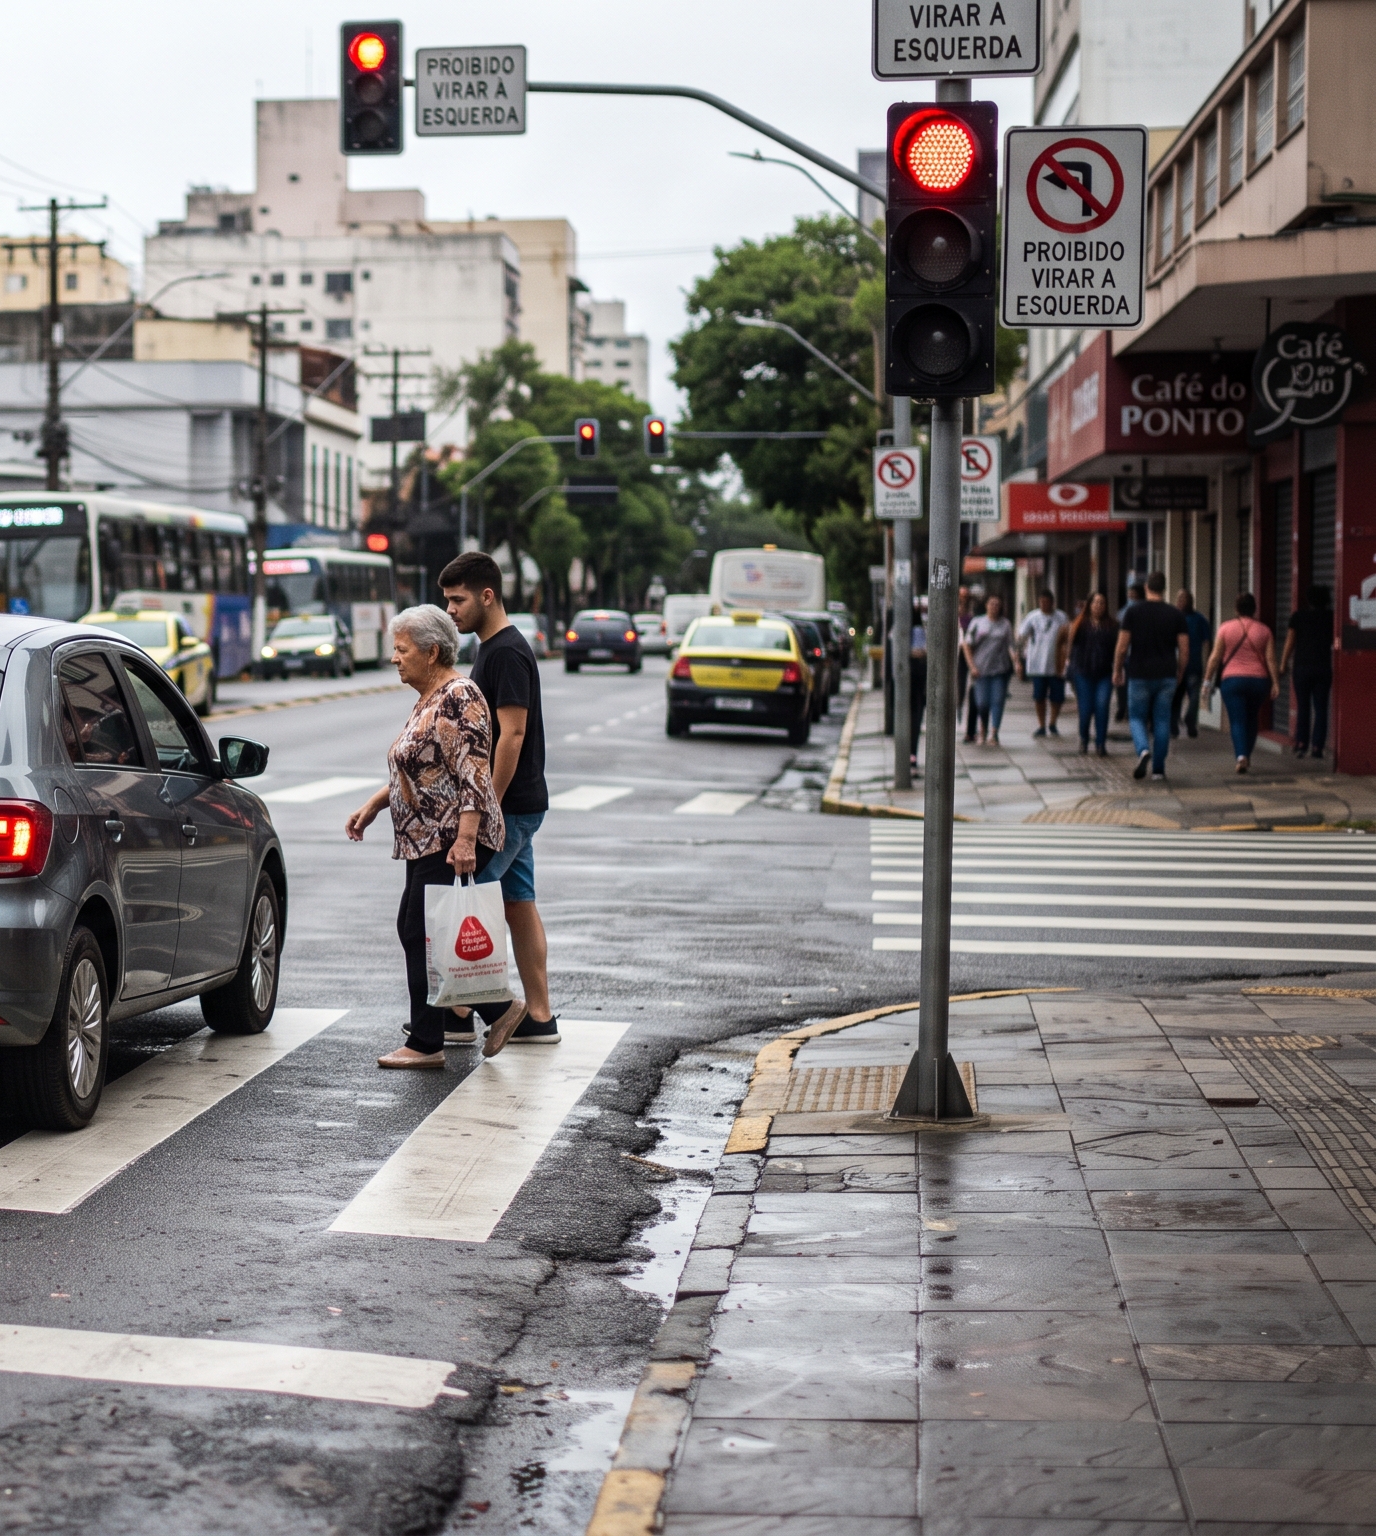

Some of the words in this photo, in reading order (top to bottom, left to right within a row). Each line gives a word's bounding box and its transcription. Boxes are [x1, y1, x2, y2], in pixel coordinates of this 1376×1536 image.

[909, 3, 981, 29] VIRAR
[989, 1, 1006, 26] A
[893, 34, 1022, 63] ESQUERDA
[426, 55, 515, 76] PROIBIDO
[433, 80, 488, 100] VIRAR
[423, 106, 519, 127] ESQUERDA
[1023, 241, 1125, 263] PROIBIDO
[1031, 268, 1095, 289] VIRAR
[1101, 268, 1116, 289] A
[1016, 294, 1131, 317] ESQUERDA
[1277, 331, 1344, 360] Café
[1131, 374, 1204, 402] Café
[1211, 375, 1247, 402] do
[1120, 404, 1246, 437] PONTO
